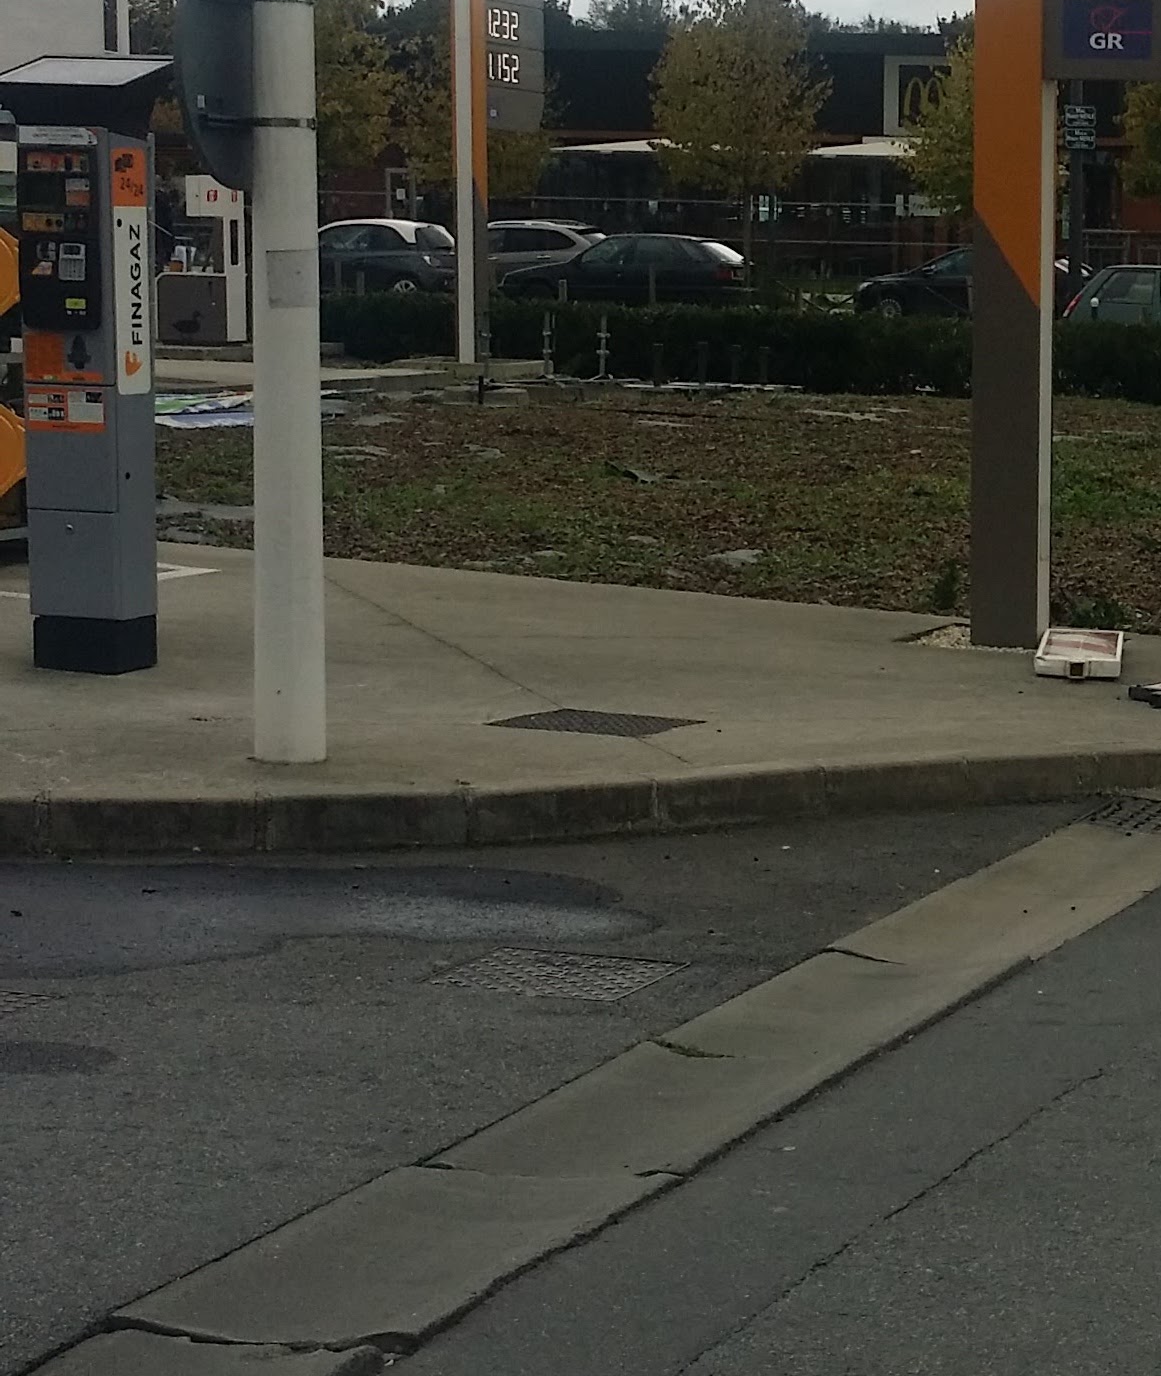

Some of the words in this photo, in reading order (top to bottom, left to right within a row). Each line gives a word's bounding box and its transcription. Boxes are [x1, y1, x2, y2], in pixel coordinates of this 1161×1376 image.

[488, 9, 519, 40] 1.232
[1089, 32, 1124, 50] GR
[488, 53, 520, 83] 1.152
[129, 224, 143, 345] FINAGAZ
